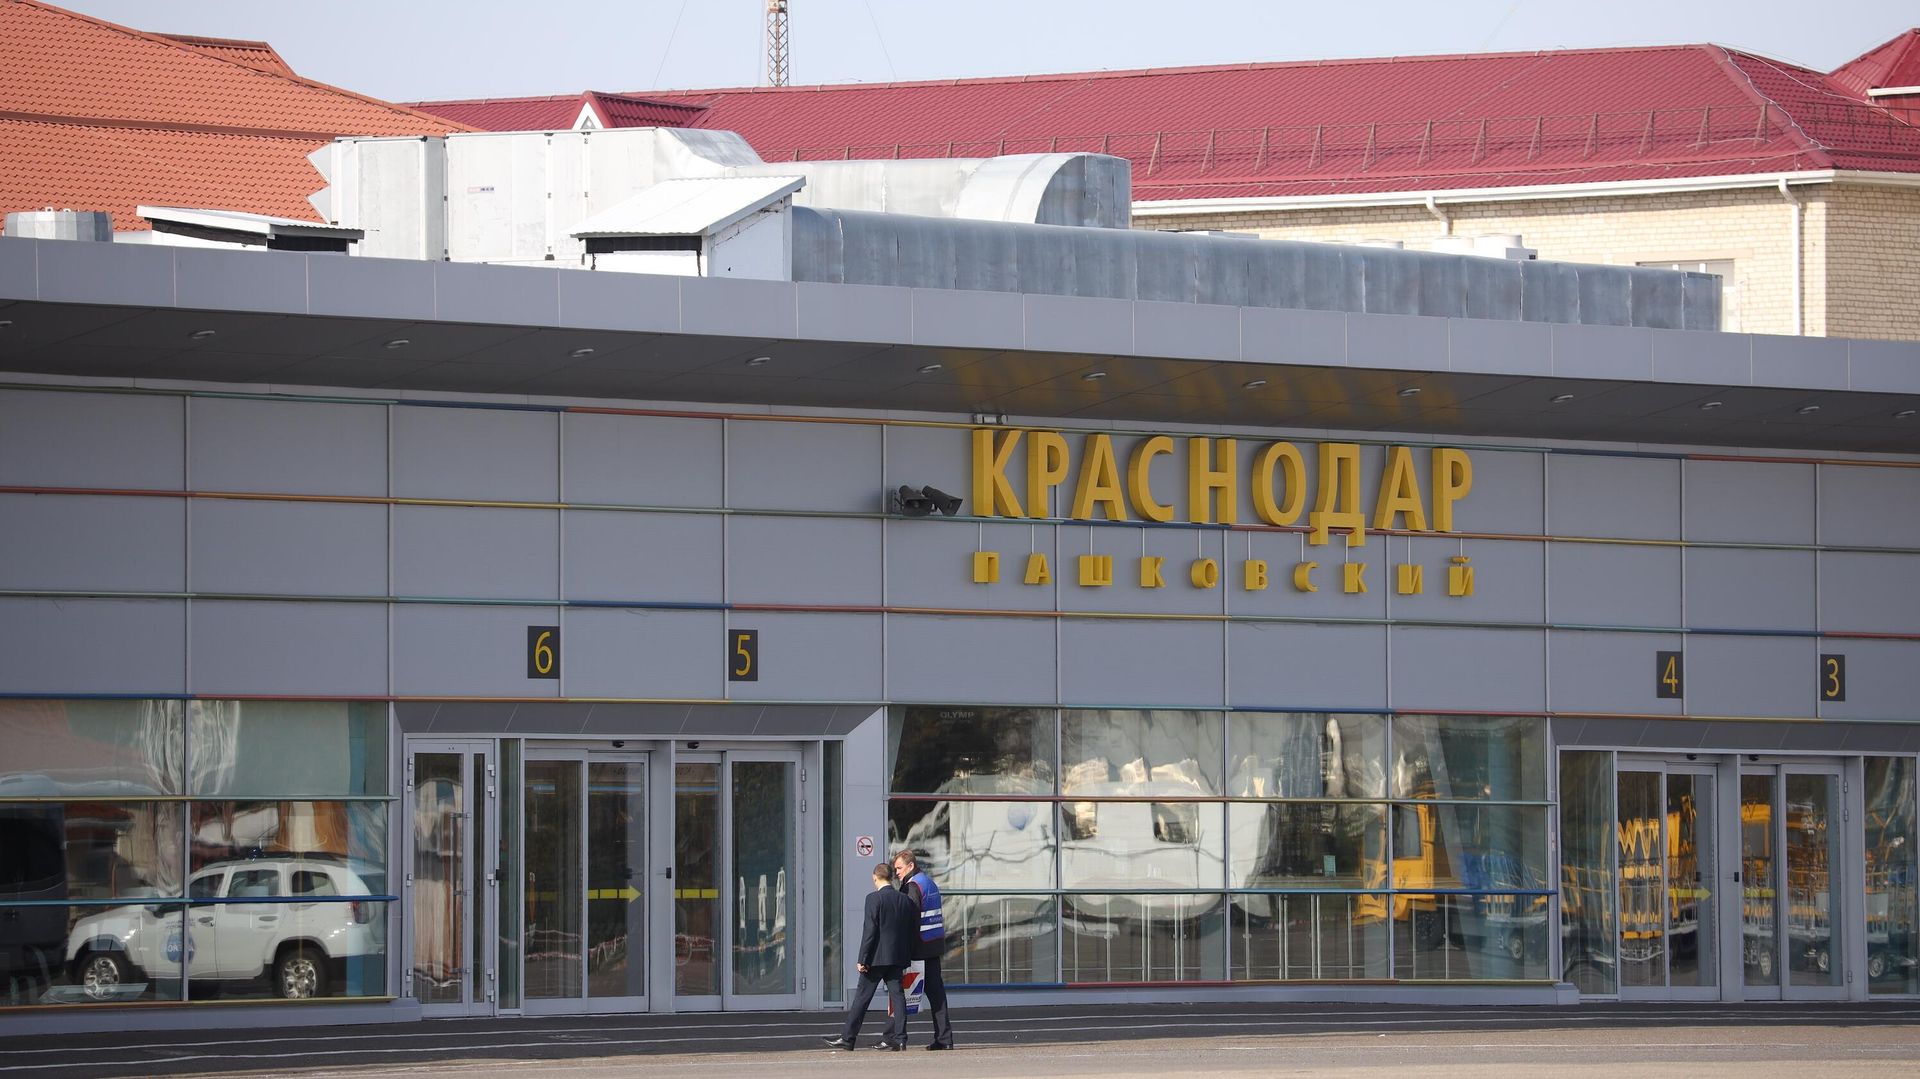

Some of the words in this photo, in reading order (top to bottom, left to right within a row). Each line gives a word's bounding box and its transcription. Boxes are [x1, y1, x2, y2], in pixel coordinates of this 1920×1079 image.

[973, 428, 1473, 547] КРАСНОДАР
[973, 552, 1474, 597] ПАШКОВСКИЙ
[534, 631, 554, 674] 6
[735, 634, 752, 676] 5
[1662, 655, 1679, 694] 4
[1825, 658, 1840, 697] 3
[939, 711, 975, 719] OLYMP
